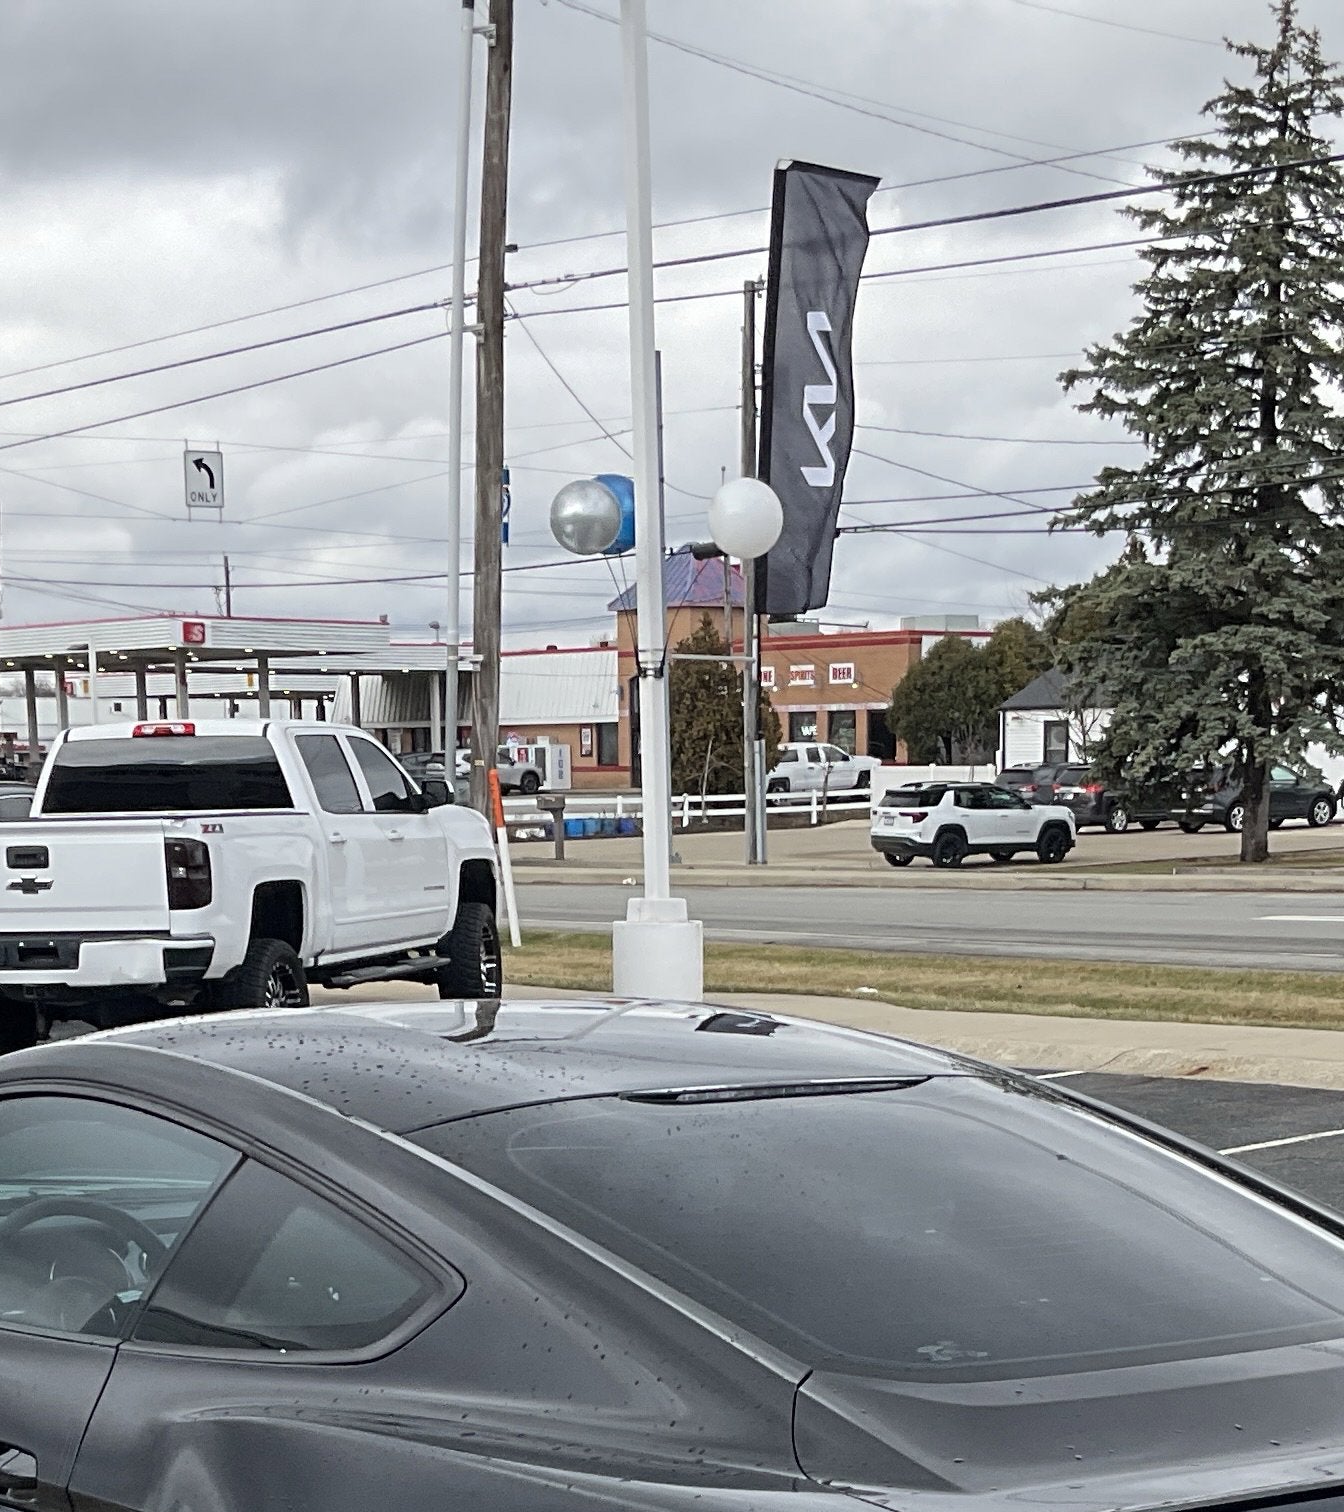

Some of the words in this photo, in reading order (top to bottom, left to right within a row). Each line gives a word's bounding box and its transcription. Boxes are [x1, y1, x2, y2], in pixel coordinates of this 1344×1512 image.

[800, 311, 838, 487] KIA
[190, 491, 218, 503] ONLY
[832, 667, 852, 681] BEER
